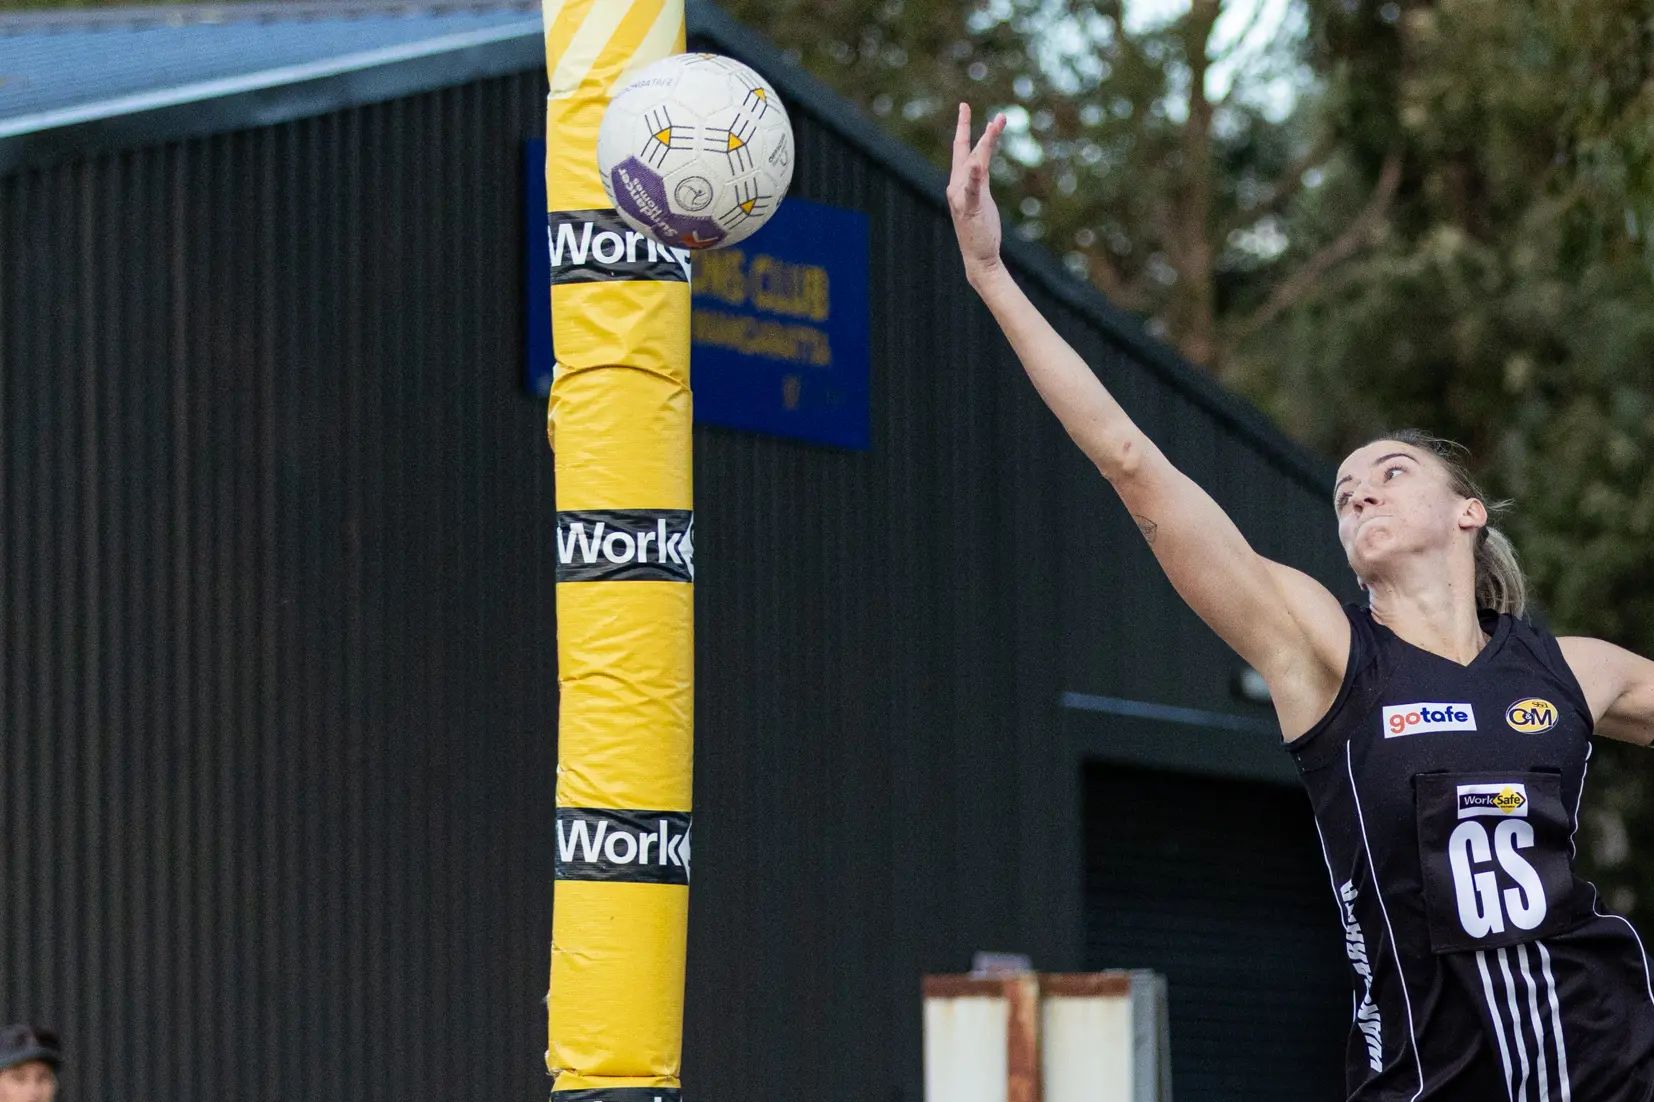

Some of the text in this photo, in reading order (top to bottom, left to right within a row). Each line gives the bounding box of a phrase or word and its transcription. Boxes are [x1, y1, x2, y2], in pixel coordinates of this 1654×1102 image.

[617, 168, 679, 237] Sundancer
[633, 178, 663, 218] Homes
[1389, 705, 1468, 734] gotafe
[1448, 818, 1547, 939] GS
